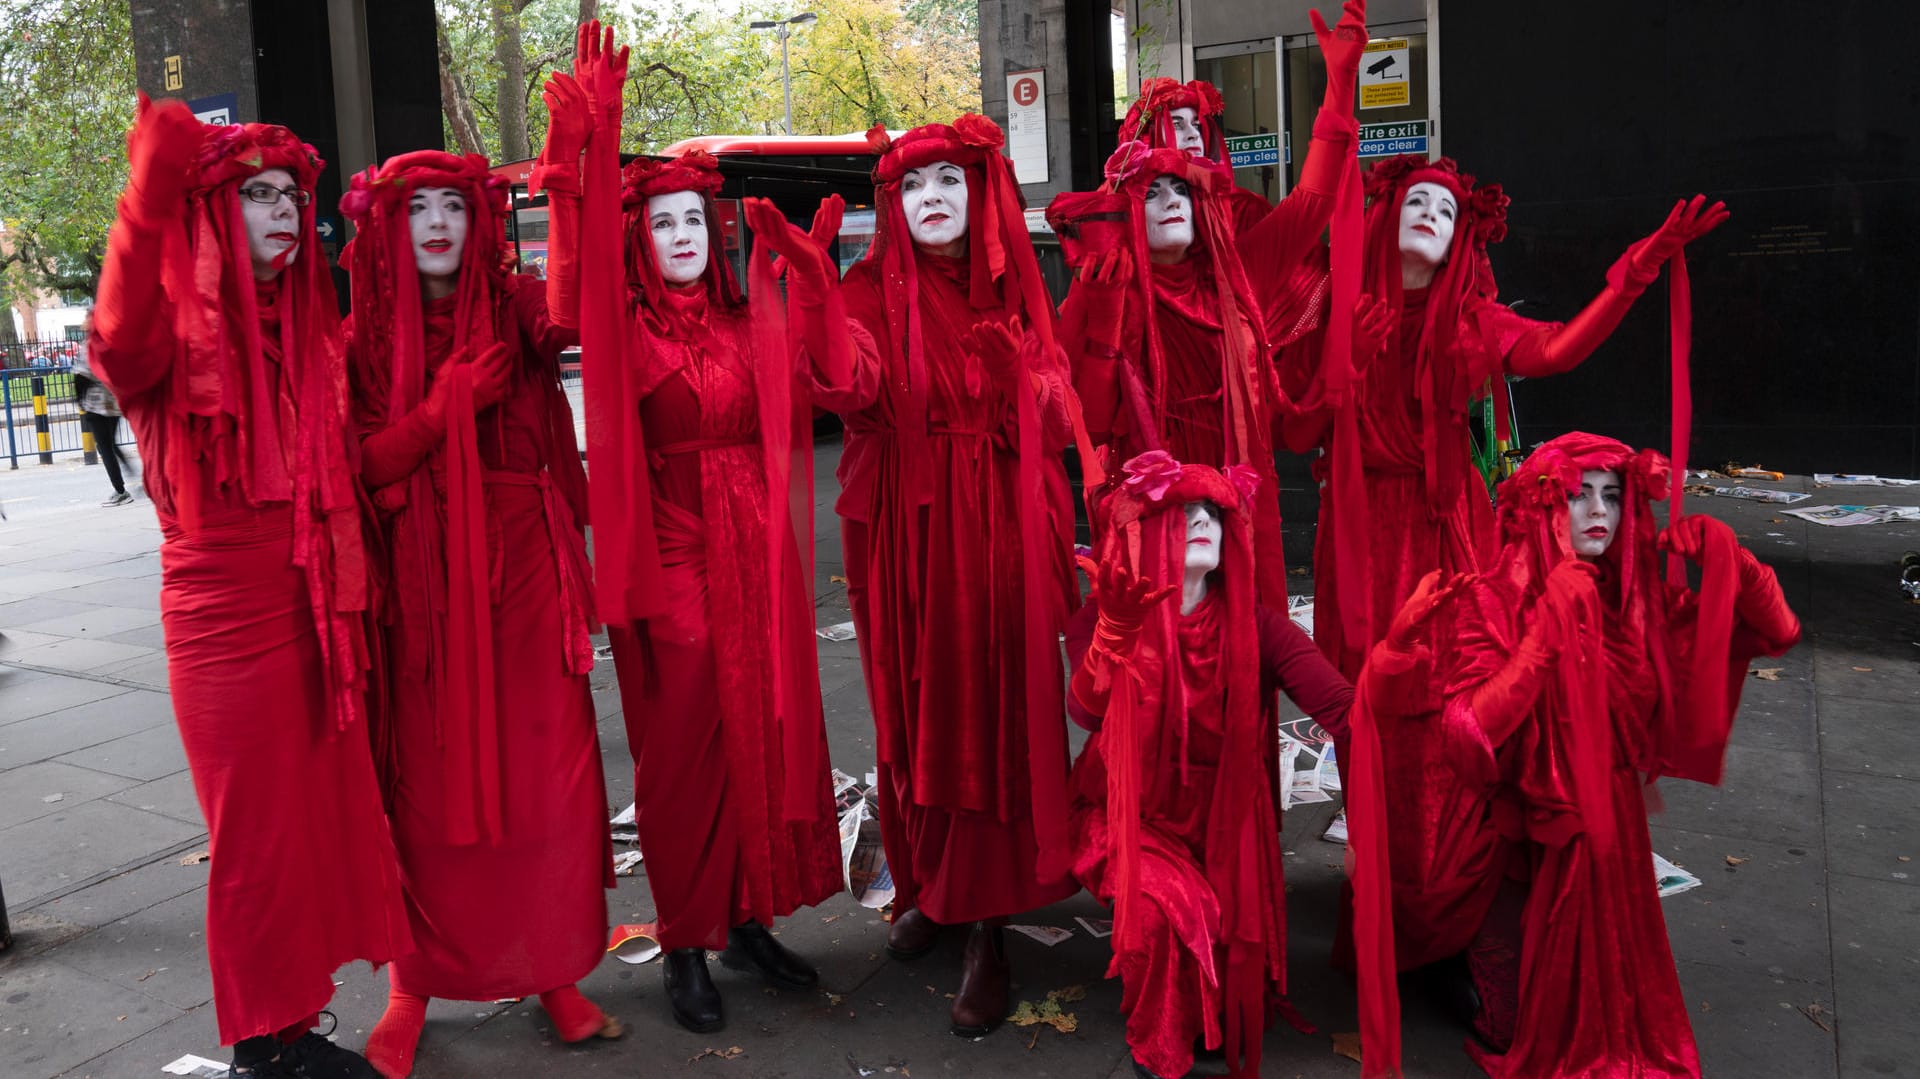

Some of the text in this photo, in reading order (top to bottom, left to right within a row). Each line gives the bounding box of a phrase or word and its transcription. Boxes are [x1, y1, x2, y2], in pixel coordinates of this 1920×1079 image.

[1020, 83, 1031, 101] E
[1010, 112, 1018, 120] 59
[1388, 124, 1418, 137] exit
[1254, 136, 1276, 149] exi
[1388, 141, 1418, 150] clear
[1231, 152, 1277, 164] eep clea
